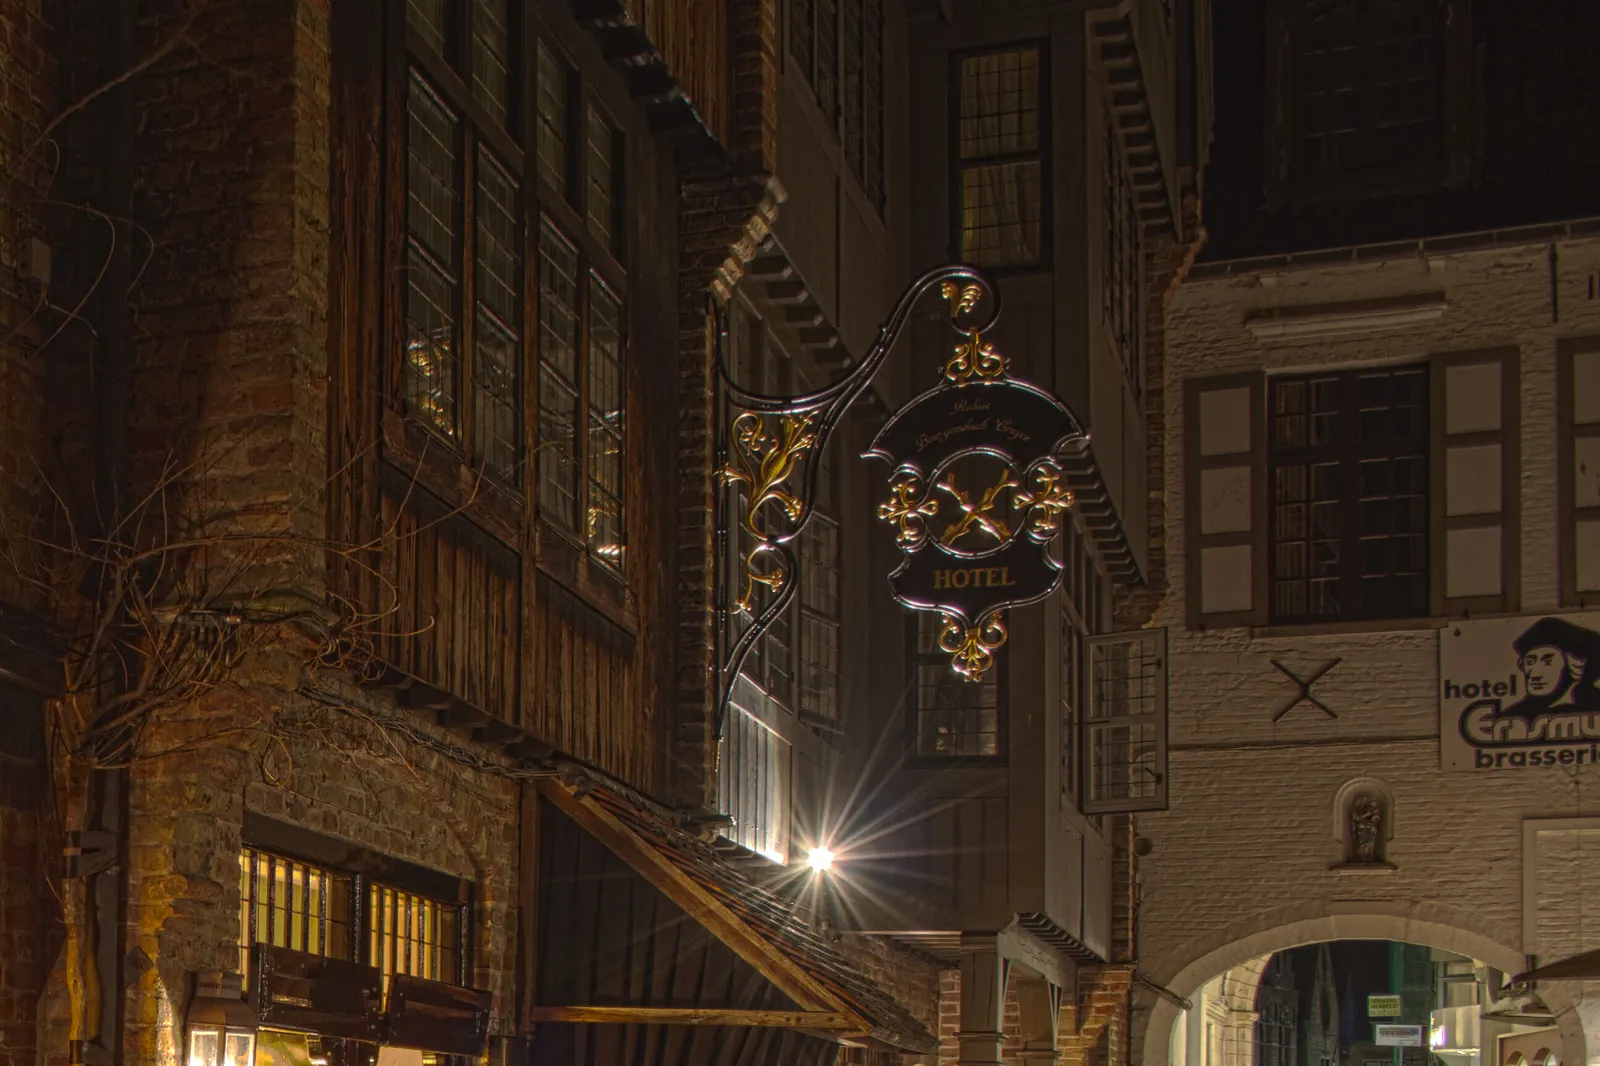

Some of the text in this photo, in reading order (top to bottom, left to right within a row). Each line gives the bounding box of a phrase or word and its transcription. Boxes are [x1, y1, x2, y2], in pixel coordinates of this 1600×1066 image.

[932, 566, 1016, 590] HOTEL
[1443, 674, 1518, 700] hotel
[1474, 744, 1600, 769] brasseri
